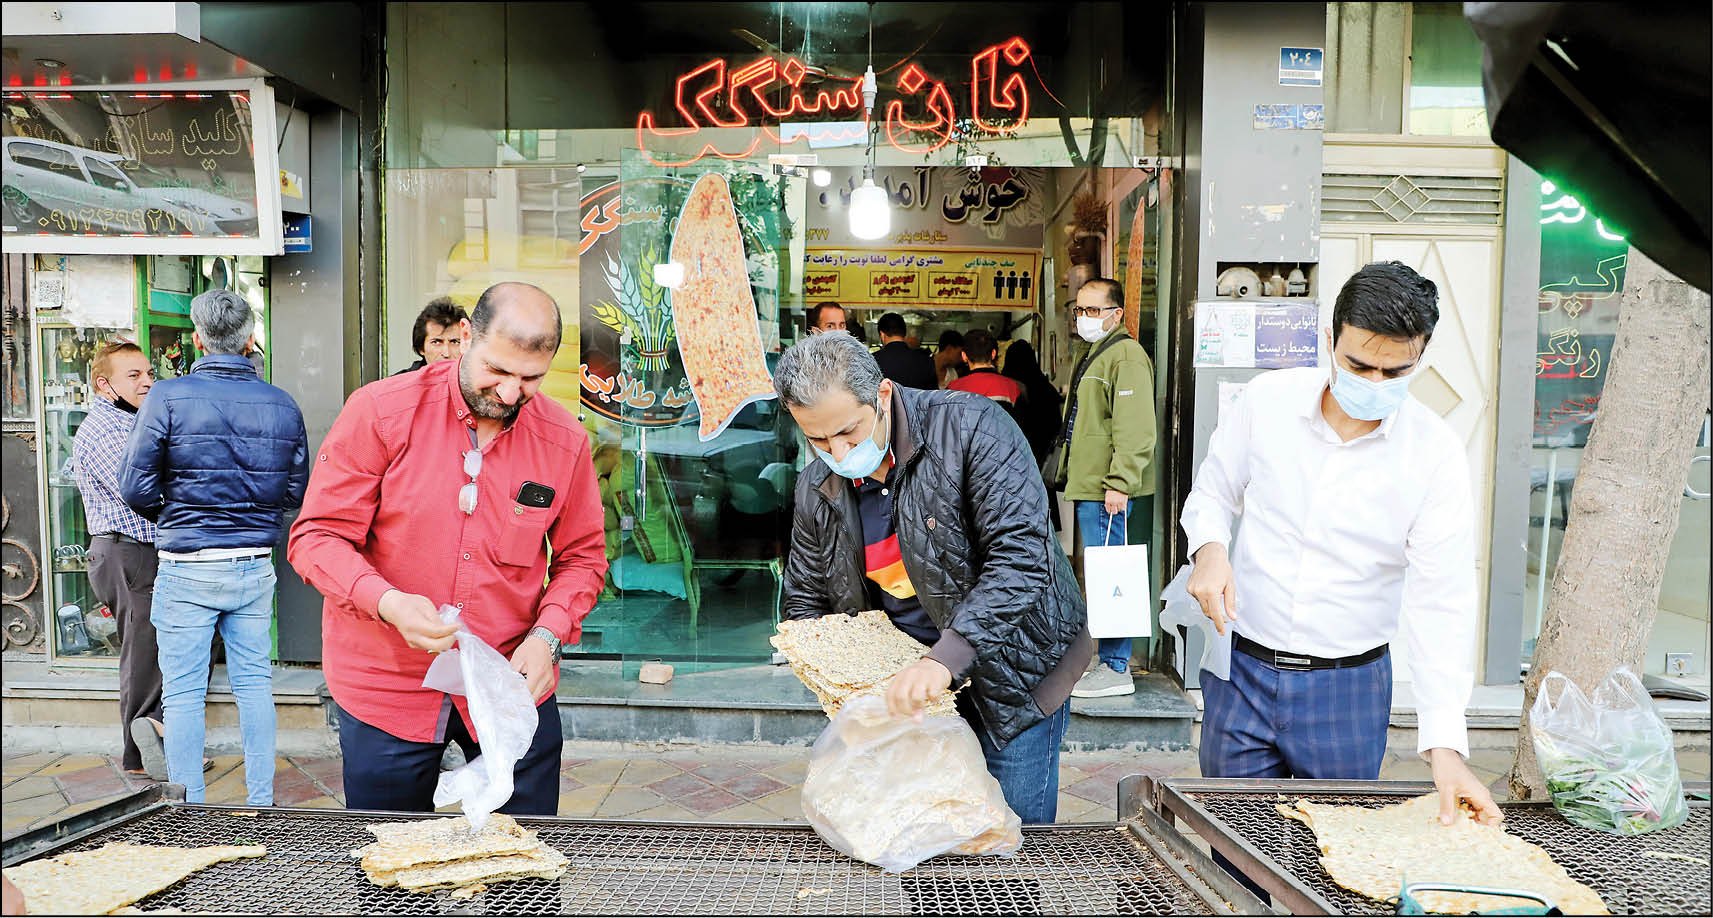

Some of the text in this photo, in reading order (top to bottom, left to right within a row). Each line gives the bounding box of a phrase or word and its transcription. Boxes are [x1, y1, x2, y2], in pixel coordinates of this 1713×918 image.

[637, 37, 1031, 168] نان سنگک
[182, 107, 245, 170] کلید
[943, 167, 1029, 223] خوش
[1288, 340, 1316, 356] محیط
